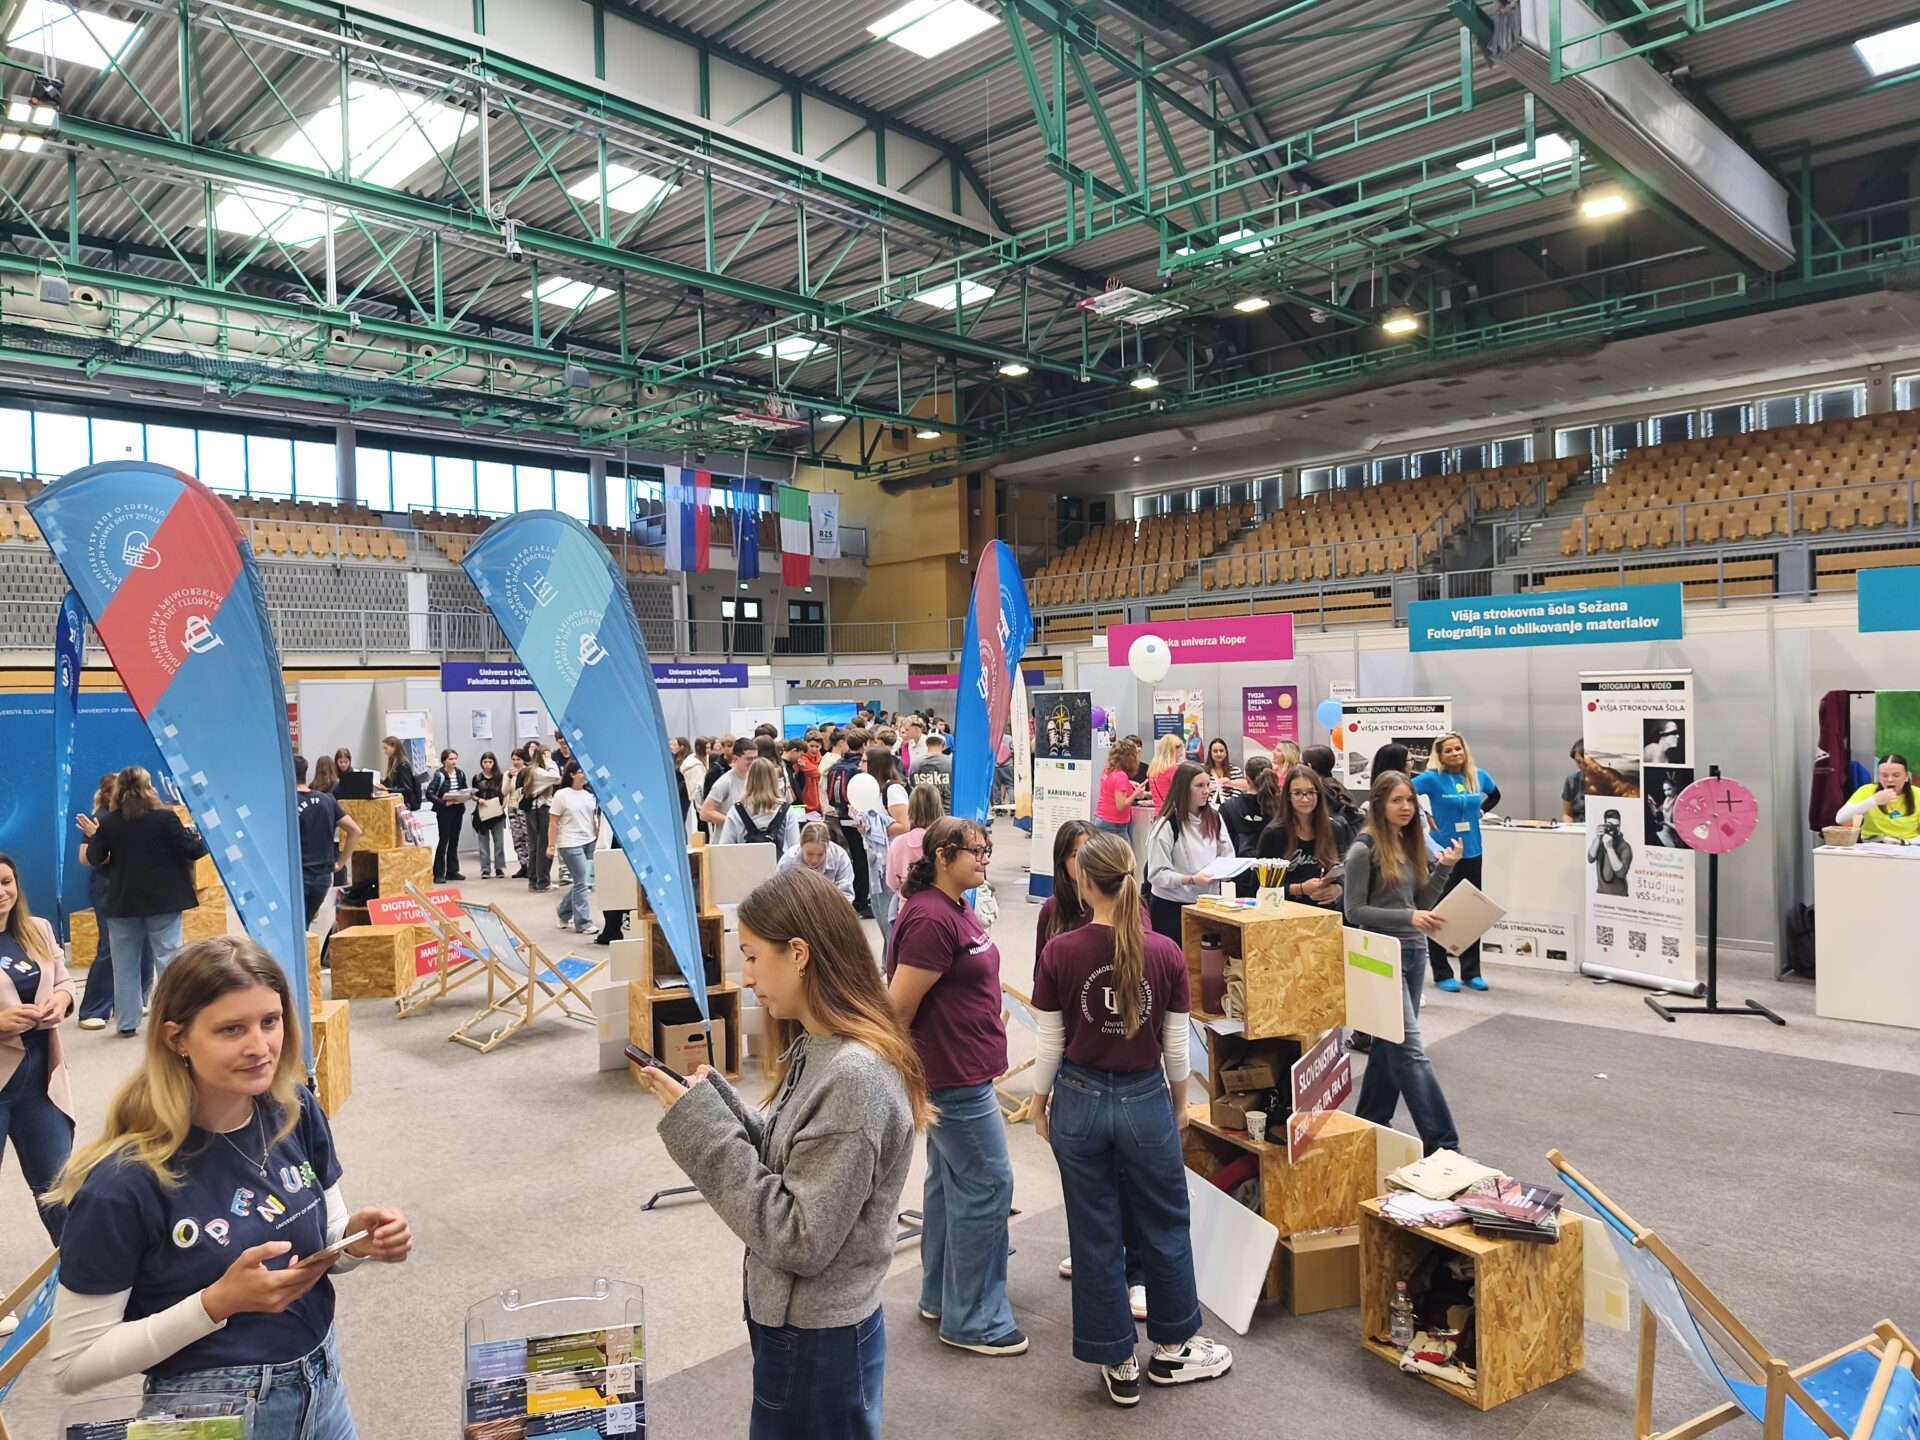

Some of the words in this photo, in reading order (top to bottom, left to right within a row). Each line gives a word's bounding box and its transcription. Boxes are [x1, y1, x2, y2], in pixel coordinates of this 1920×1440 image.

[819, 530, 833, 538] RZS
[1451, 610, 1481, 623] Višja
[1483, 607, 1545, 620] strokovna
[1547, 604, 1574, 615] šola
[1578, 600, 1628, 614] Sežana
[1427, 626, 1491, 641] Fotografija
[1494, 624, 1506, 636] in
[1509, 619, 1583, 635] oblikovanje
[1586, 616, 1659, 631] materialov
[1181, 637, 1217, 647] univerza
[1219, 635, 1246, 647] Koper
[1360, 724, 1379, 732] VIŠJA
[1425, 723, 1445, 731] ŠOLA
[913, 771, 950, 785] osaka
[1072, 790, 1086, 798] PLAC
[1637, 877, 1676, 894] študiju
[1636, 891, 1650, 901] VSŠ
[394, 913, 401, 921] V
[1510, 924, 1547, 934] STROKOVNA
[1548, 927, 1565, 936] ŠOLA
[428, 959, 433, 967] V
[1083, 981, 1091, 989] OF
[1088, 964, 1114, 982] PRIMORS
[1298, 1038, 1339, 1094] SLOVENISTIKA
[172, 1187, 286, 1249] OPEN
[275, 1212, 301, 1230] UNIVERSITY
[301, 1207, 307, 1215] OF
